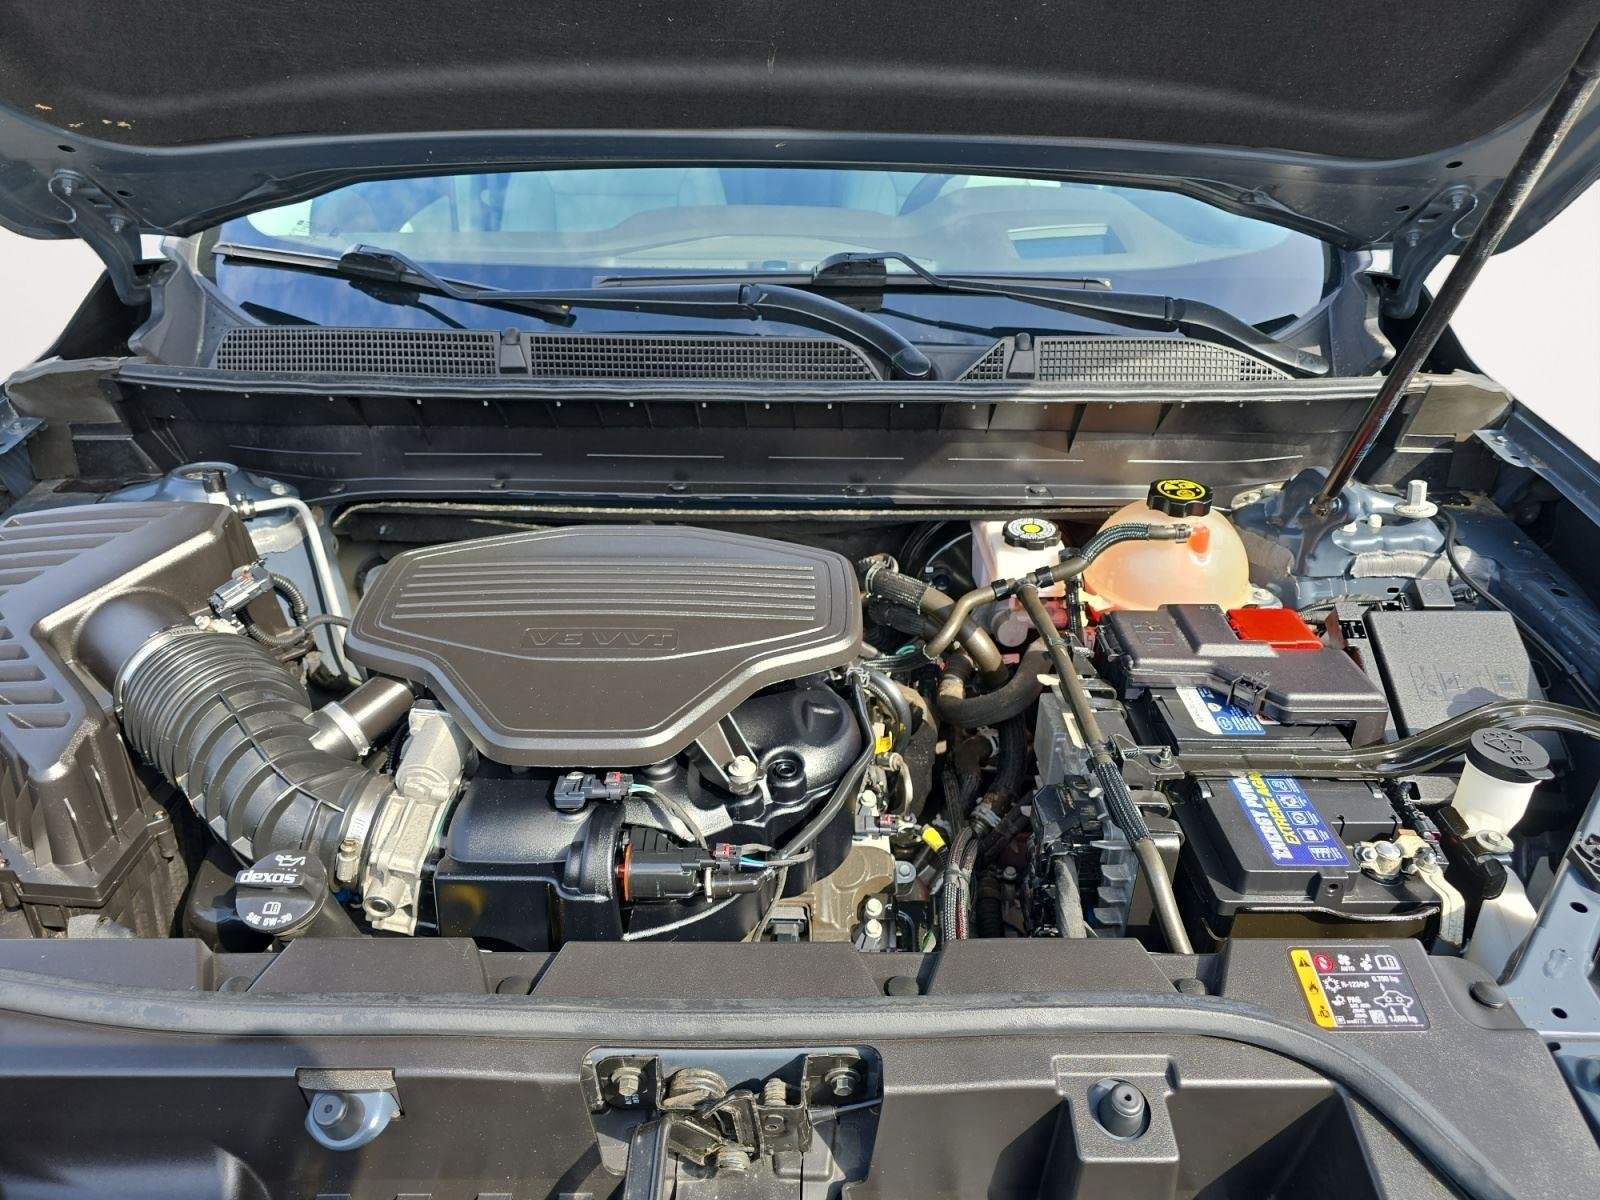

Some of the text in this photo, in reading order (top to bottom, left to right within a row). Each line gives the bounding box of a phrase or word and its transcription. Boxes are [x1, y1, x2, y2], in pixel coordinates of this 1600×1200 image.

[529, 632, 673, 646] V6 VVT
[1261, 796, 1301, 845] EXTREME
[240, 870, 299, 884] dexos
[246, 911, 262, 925] SAE
